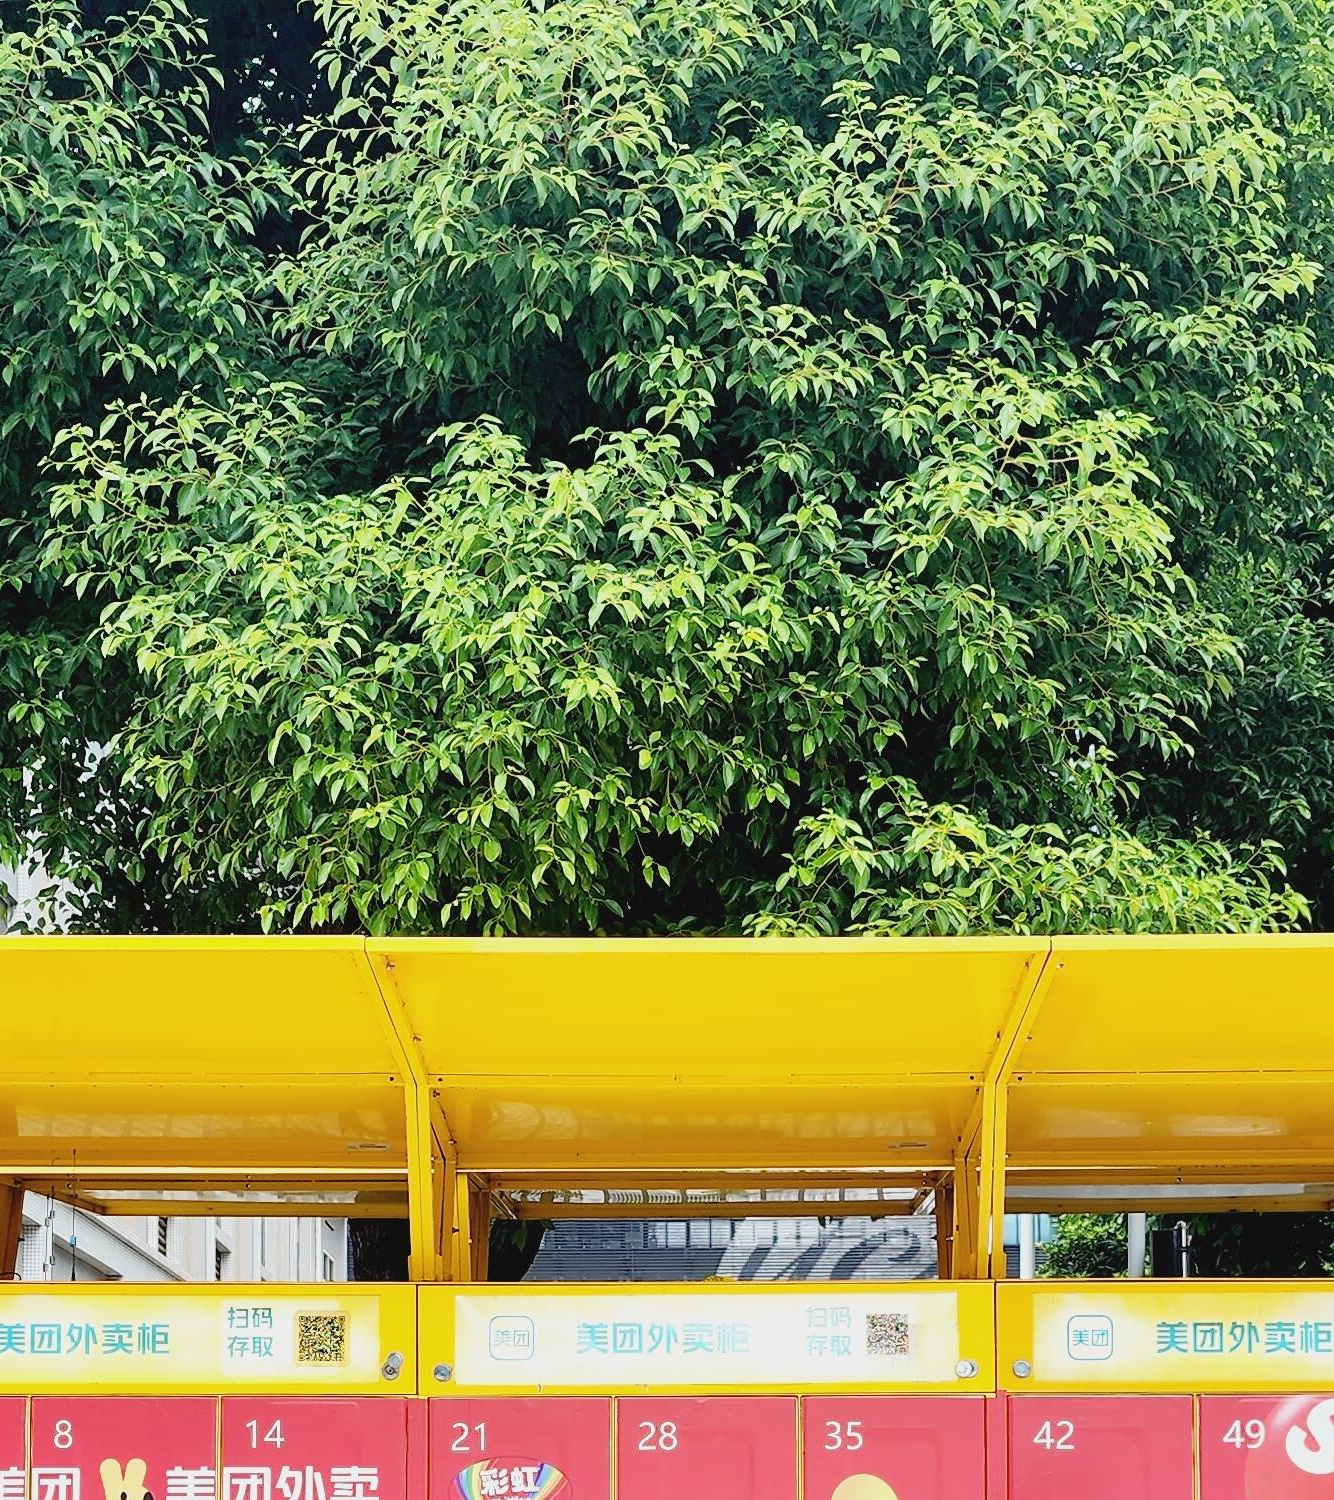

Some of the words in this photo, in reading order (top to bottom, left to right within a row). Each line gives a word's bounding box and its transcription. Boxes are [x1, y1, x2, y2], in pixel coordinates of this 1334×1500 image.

[227, 1306, 274, 1330] 扫码
[805, 1306, 852, 1329] 扫码
[227, 1335, 274, 1359] 存取
[493, 1328, 530, 1348] 美团
[576, 1321, 750, 1355] 美团外卖柜
[805, 1334, 852, 1357] 存取
[1071, 1328, 1109, 1348] 美团
[1155, 1321, 1333, 1355] 美团外卖柜
[53, 1419, 73, 1448] 8
[245, 1420, 285, 1448] 14
[450, 1422, 488, 1451] 21
[637, 1421, 678, 1451] 28
[824, 1421, 864, 1450] 35
[1033, 1421, 1075, 1450] 42
[1222, 1420, 1265, 1449] 49
[479, 1466, 541, 1497] 彩虹
